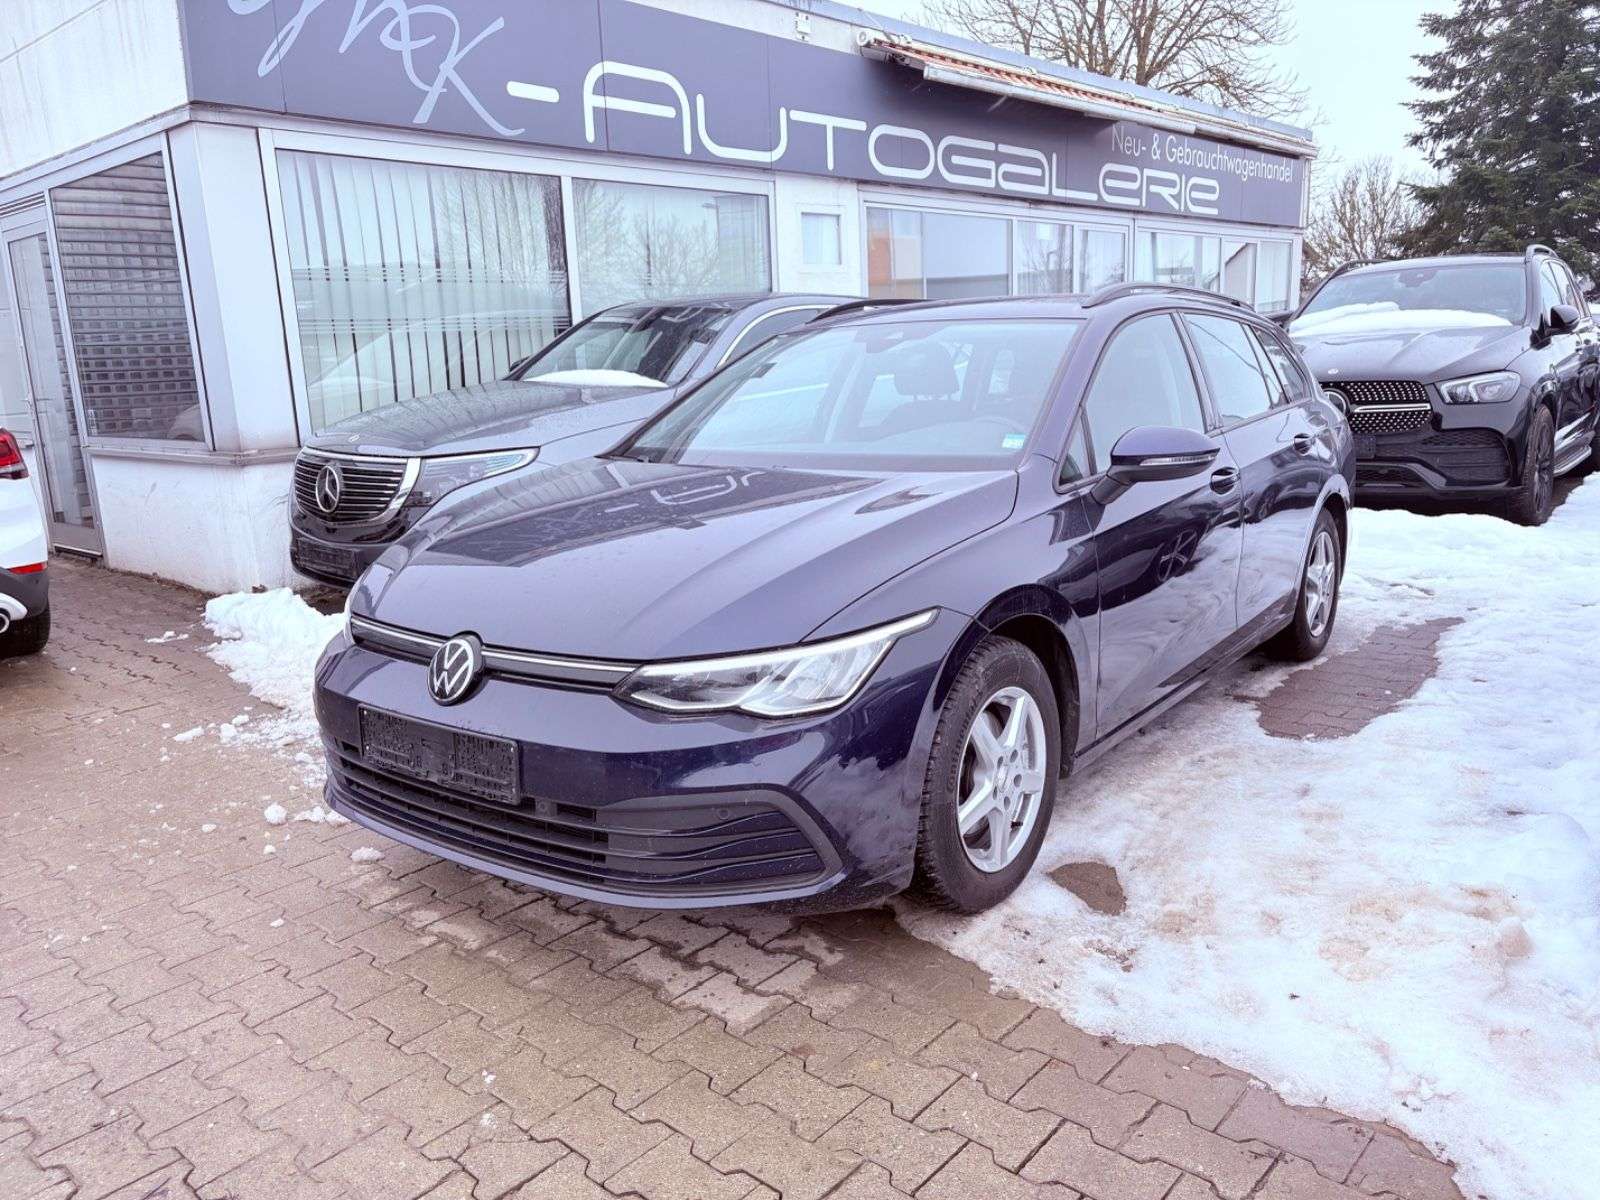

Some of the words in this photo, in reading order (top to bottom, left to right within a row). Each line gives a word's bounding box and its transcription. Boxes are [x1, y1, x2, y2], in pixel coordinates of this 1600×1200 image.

[1111, 123, 1147, 158] Neu-
[1151, 132, 1162, 161] &
[1165, 134, 1294, 184] Gebrauchtwagenhandel
[428, 639, 475, 702] VW
